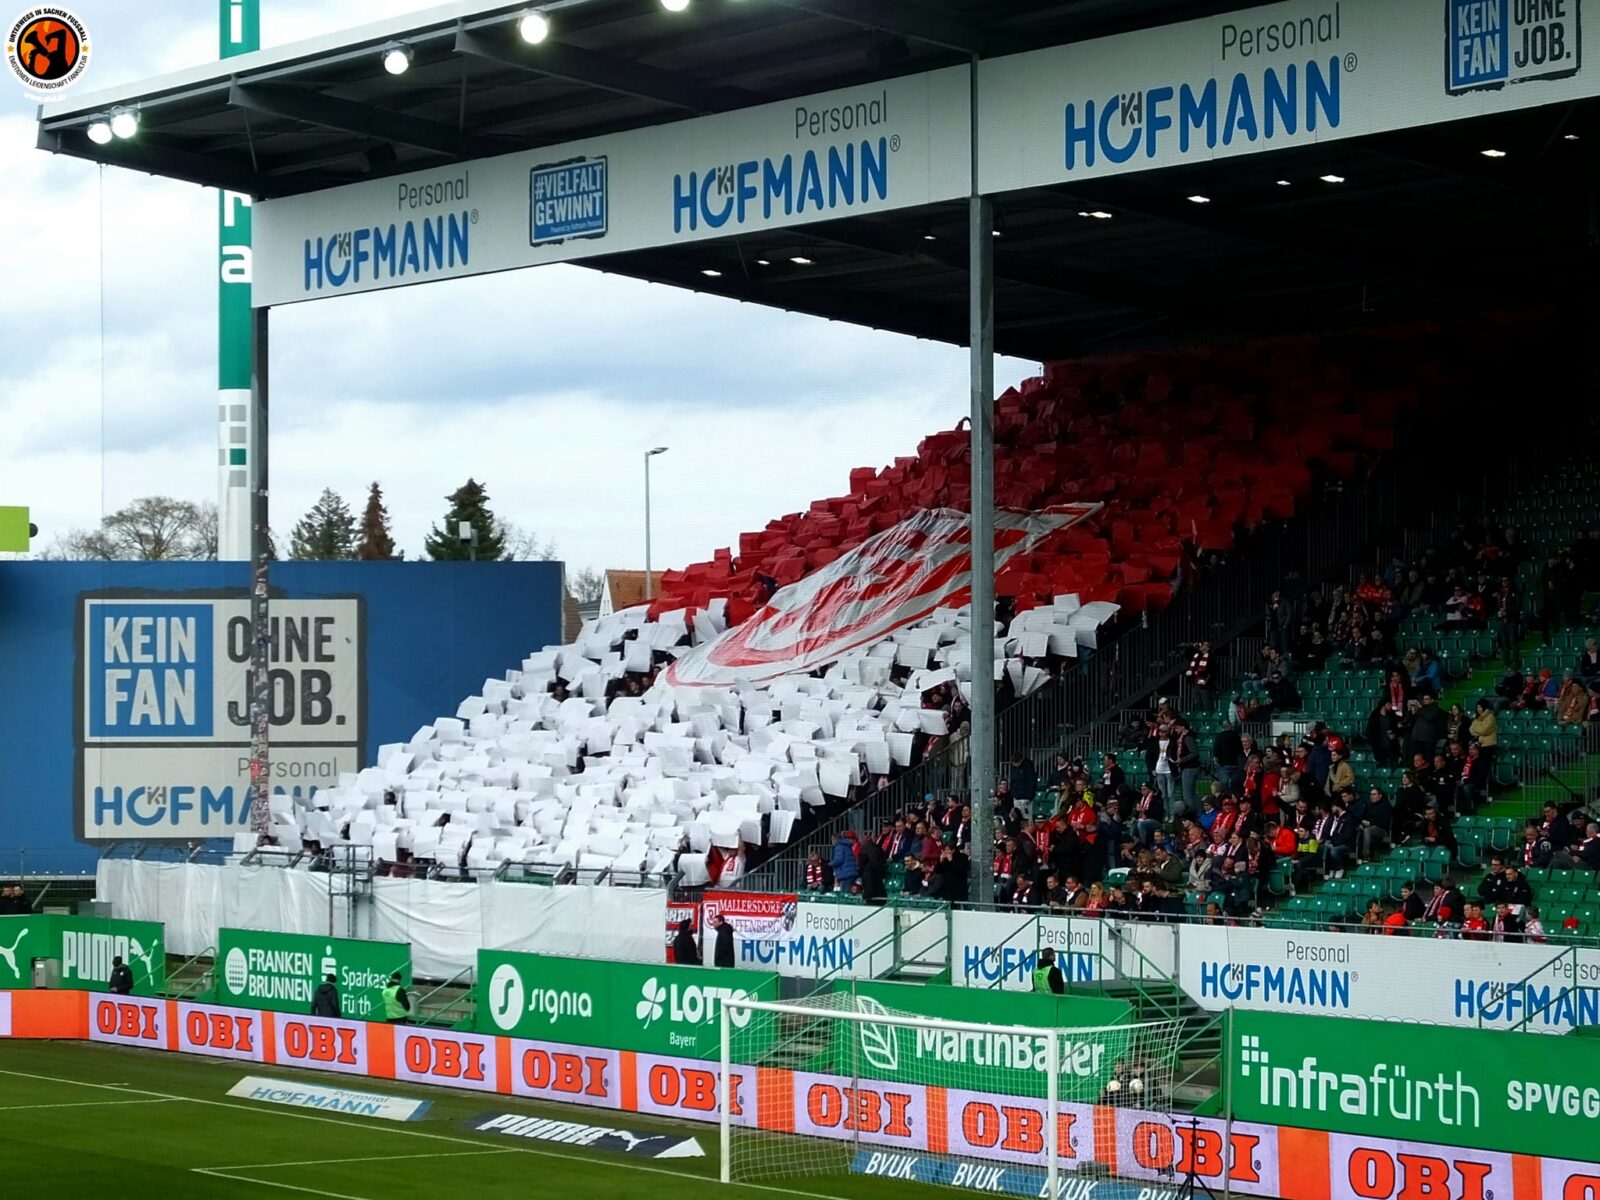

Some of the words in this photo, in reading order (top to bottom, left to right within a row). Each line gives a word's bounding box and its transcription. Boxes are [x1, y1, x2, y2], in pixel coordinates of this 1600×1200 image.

[1222, 2, 1340, 60] Personal
[1458, 0, 1500, 37] KEIN
[1458, 34, 1500, 78] FAN
[1514, 22, 1571, 68] JOB.
[796, 90, 887, 139] Personal
[1065, 56, 1340, 170] HOFMANN
[399, 170, 469, 211] Personal
[535, 165, 602, 200] #VIELFALT
[674, 137, 887, 233] HOFMANN
[536, 192, 603, 226] GEWINNT
[305, 211, 469, 291] HOFMANN
[104, 617, 195, 663] KEIN
[105, 669, 195, 726] FAN
[227, 669, 346, 726] JOB.
[238, 757, 337, 778] Prsonal
[806, 912, 853, 932] Personal
[63, 931, 129, 982] PUMA
[248, 949, 312, 976] FRANKEN
[741, 935, 853, 970] HOFMANN
[964, 944, 1094, 983] HOFMNN
[1287, 940, 1350, 963] Personal
[248, 977, 312, 1002] BRUNNEN
[342, 993, 372, 1016] Füth
[528, 988, 592, 1024] signia
[1201, 961, 1350, 1009] HOFMANN
[97, 1001, 158, 1040] OBI
[187, 1011, 253, 1051] OBI
[284, 1021, 357, 1065] OBI
[404, 1035, 485, 1081] OBI
[522, 1049, 608, 1097] OBI
[1260, 1051, 1480, 1127] infrafürth
[1507, 1080, 1600, 1118] SPVGG
[475, 1113, 616, 1147] PUMA
[807, 1083, 911, 1137] OBI
[1133, 1121, 1260, 1183] OBI
[1348, 1147, 1492, 1200] OBI
